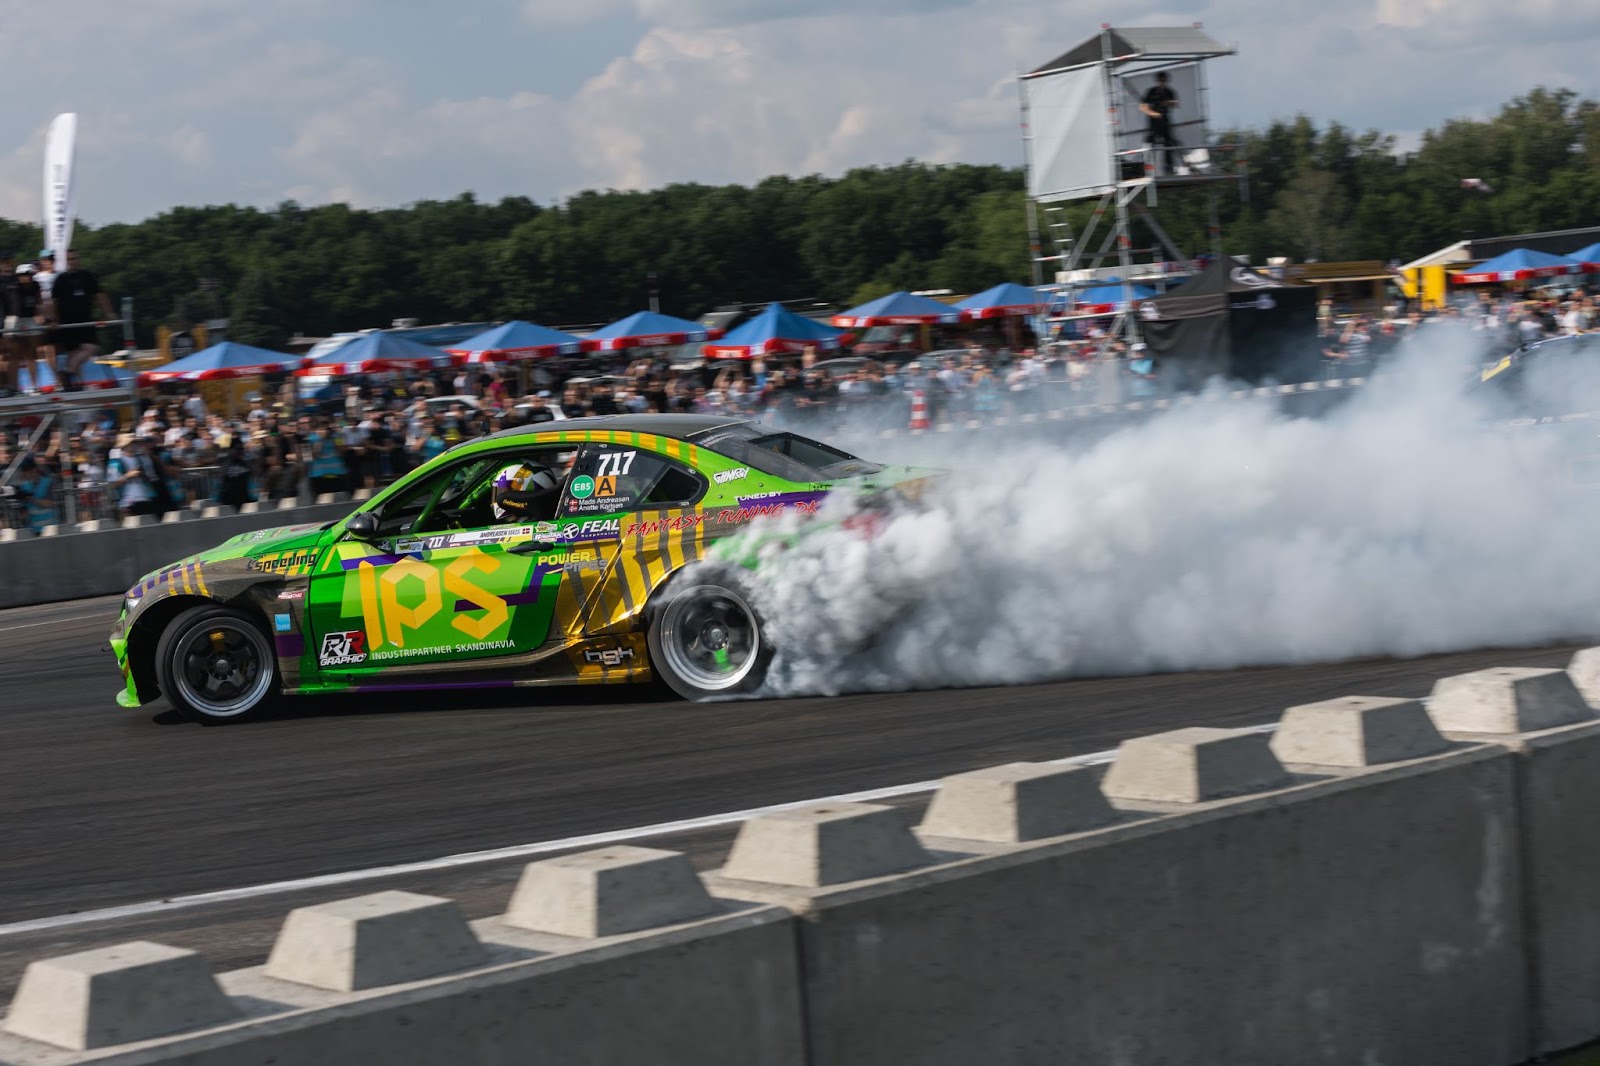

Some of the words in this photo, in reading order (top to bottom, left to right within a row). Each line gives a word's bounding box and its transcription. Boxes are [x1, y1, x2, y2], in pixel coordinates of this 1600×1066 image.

[597, 450, 637, 477] 717
[574, 482, 591, 492] E85
[597, 477, 614, 496] A
[579, 498, 596, 506] Mads
[597, 496, 630, 504] Andreasen
[733, 492, 767, 502] TUNED
[768, 490, 783, 498] BY
[793, 500, 821, 517] DK
[480, 530, 507, 538] ANDREASEN
[580, 519, 620, 534] FEAL
[428, 536, 445, 549] 717
[538, 551, 591, 566] POWER
[564, 558, 608, 572] PIPES
[358, 547, 509, 651] IPS
[372, 645, 451, 661] INDUSTRIPARTNER
[455, 639, 516, 652] SKANDINAVIA
[320, 652, 367, 667] GRAPHIC
